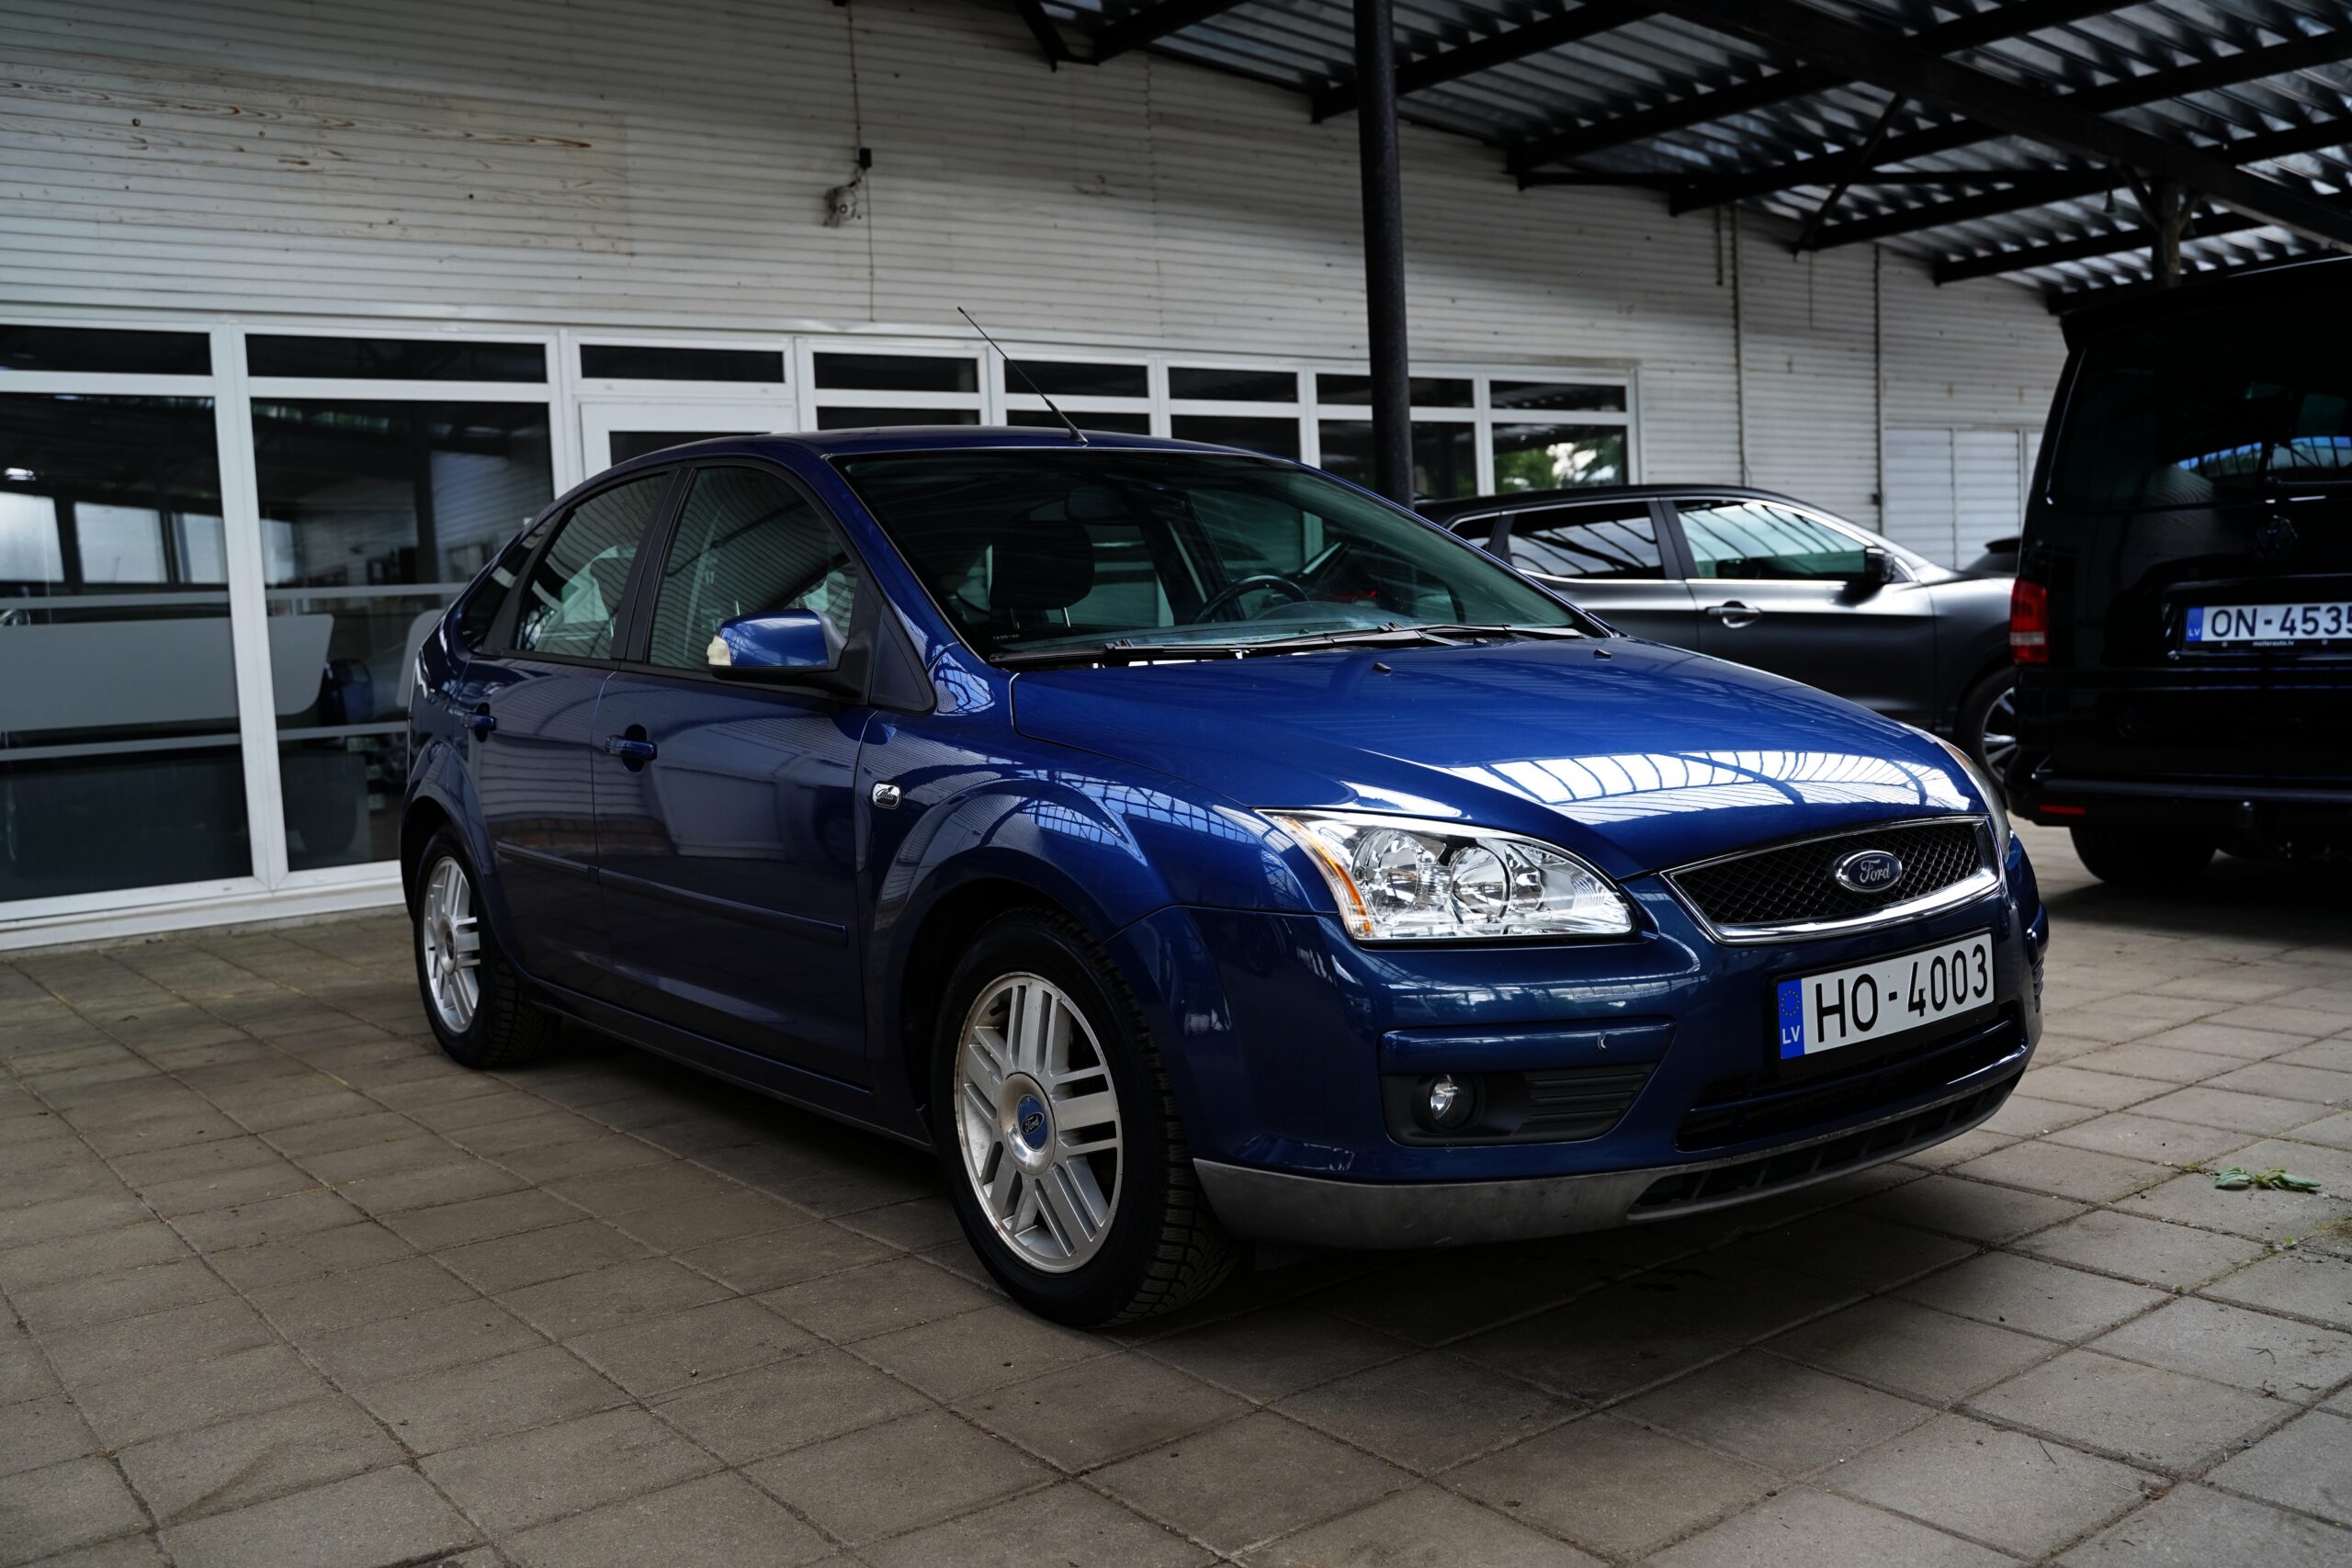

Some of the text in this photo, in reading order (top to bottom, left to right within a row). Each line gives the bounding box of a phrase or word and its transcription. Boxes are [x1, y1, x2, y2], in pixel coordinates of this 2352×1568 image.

[2188, 627, 2201, 637] LV
[1860, 859, 1891, 884] Ford
[1781, 943, 1988, 1045] LV HO-4003
[1024, 1115, 1040, 1133] Ford
